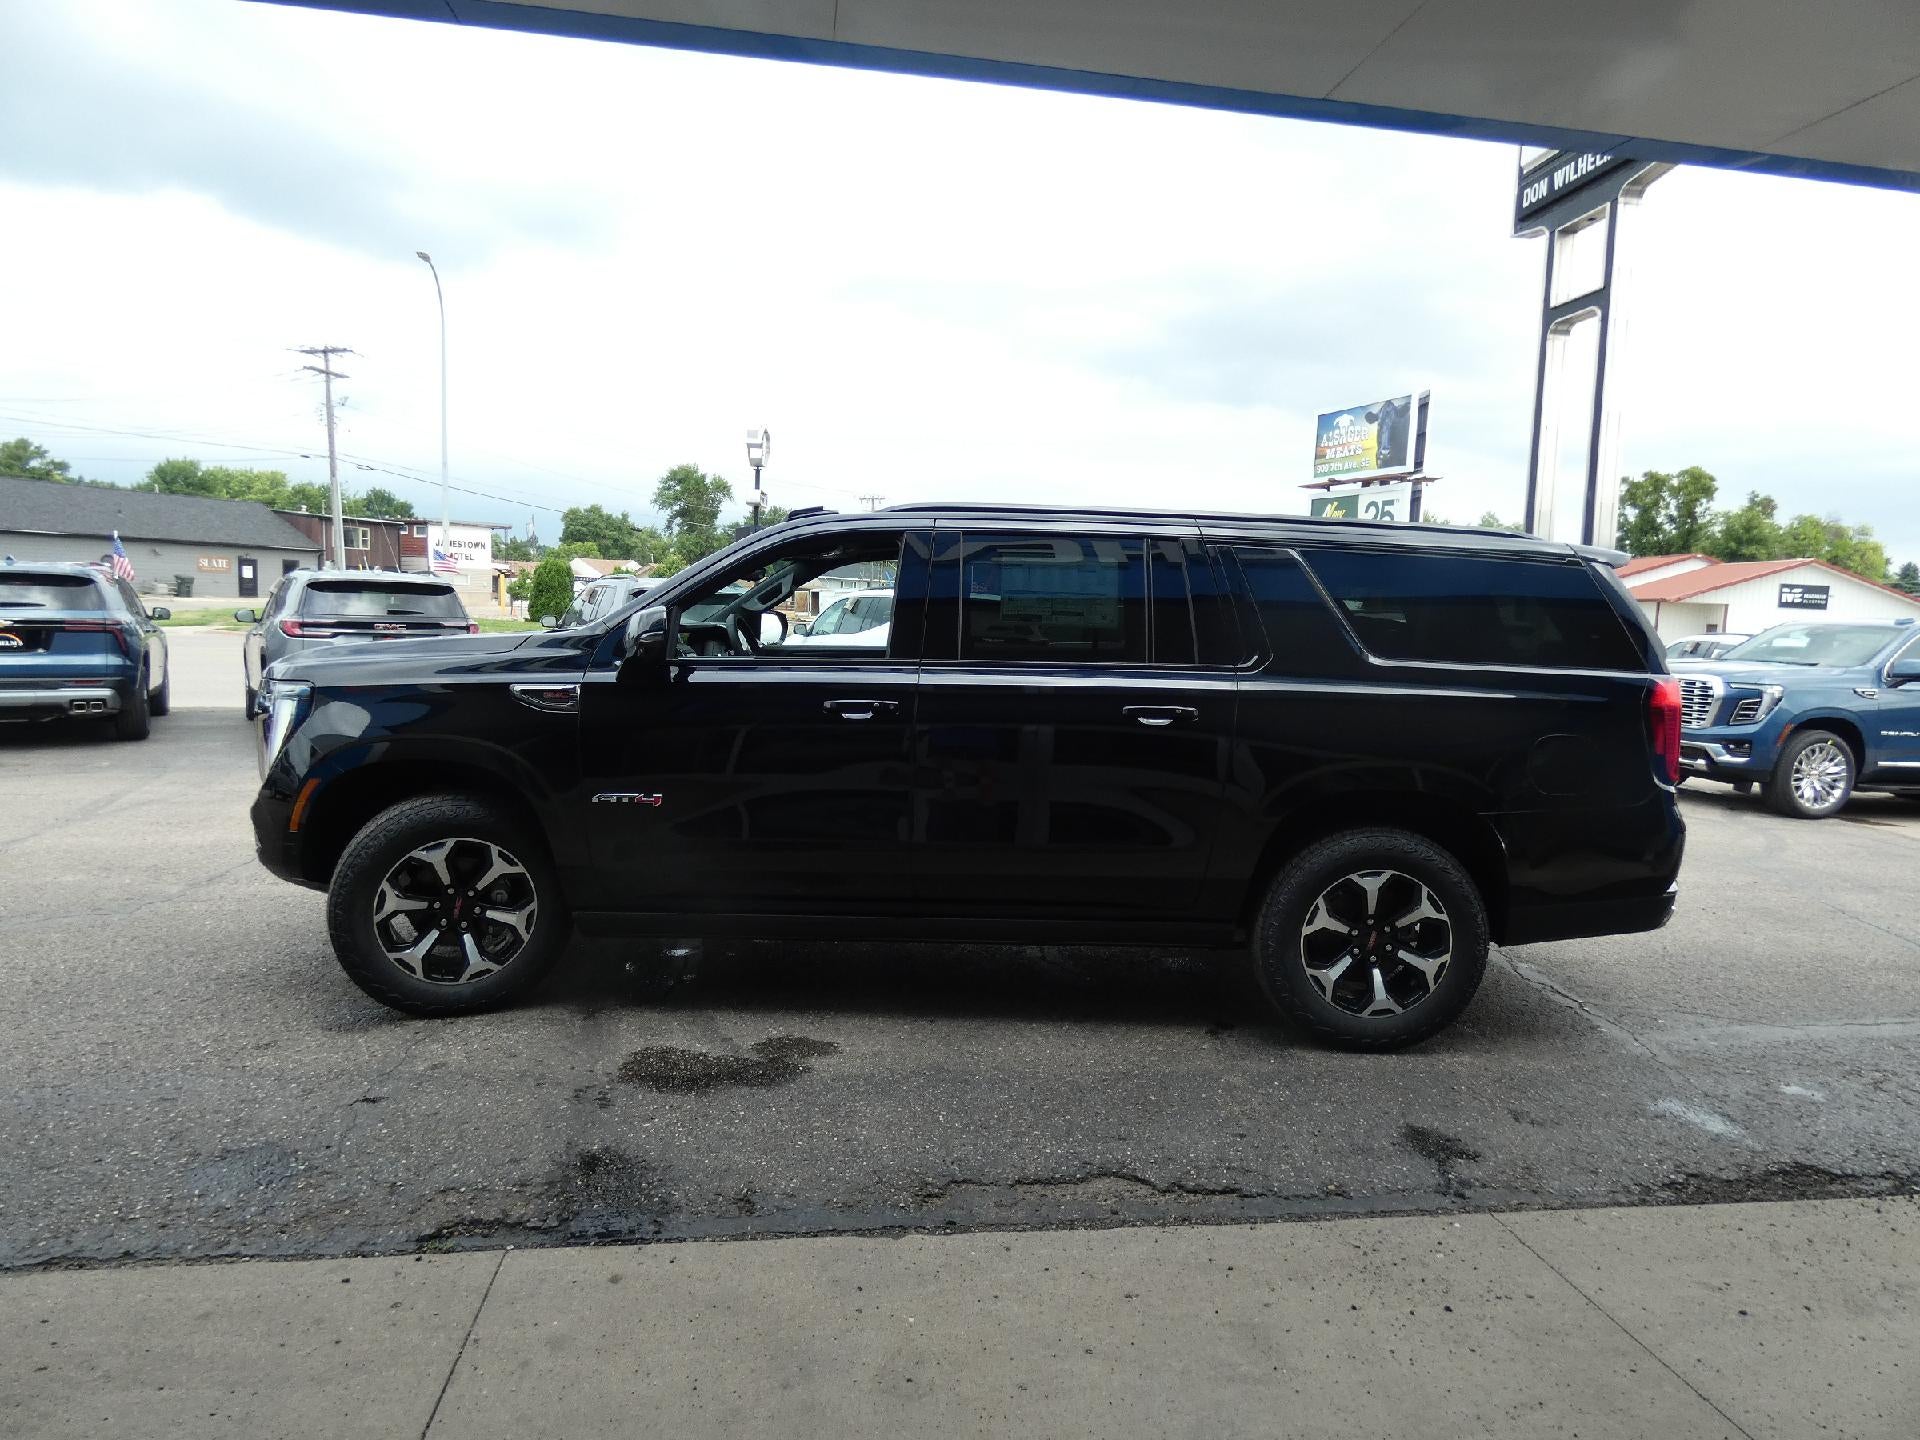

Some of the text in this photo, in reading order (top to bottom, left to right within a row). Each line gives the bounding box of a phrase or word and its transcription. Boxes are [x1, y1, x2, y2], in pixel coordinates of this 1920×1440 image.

[1522, 177, 1549, 209] DON
[1326, 447, 1363, 459] MEATS
[198, 558, 230, 569] SLATE
[374, 623, 407, 631] GMC
[591, 793, 663, 807] AT4
